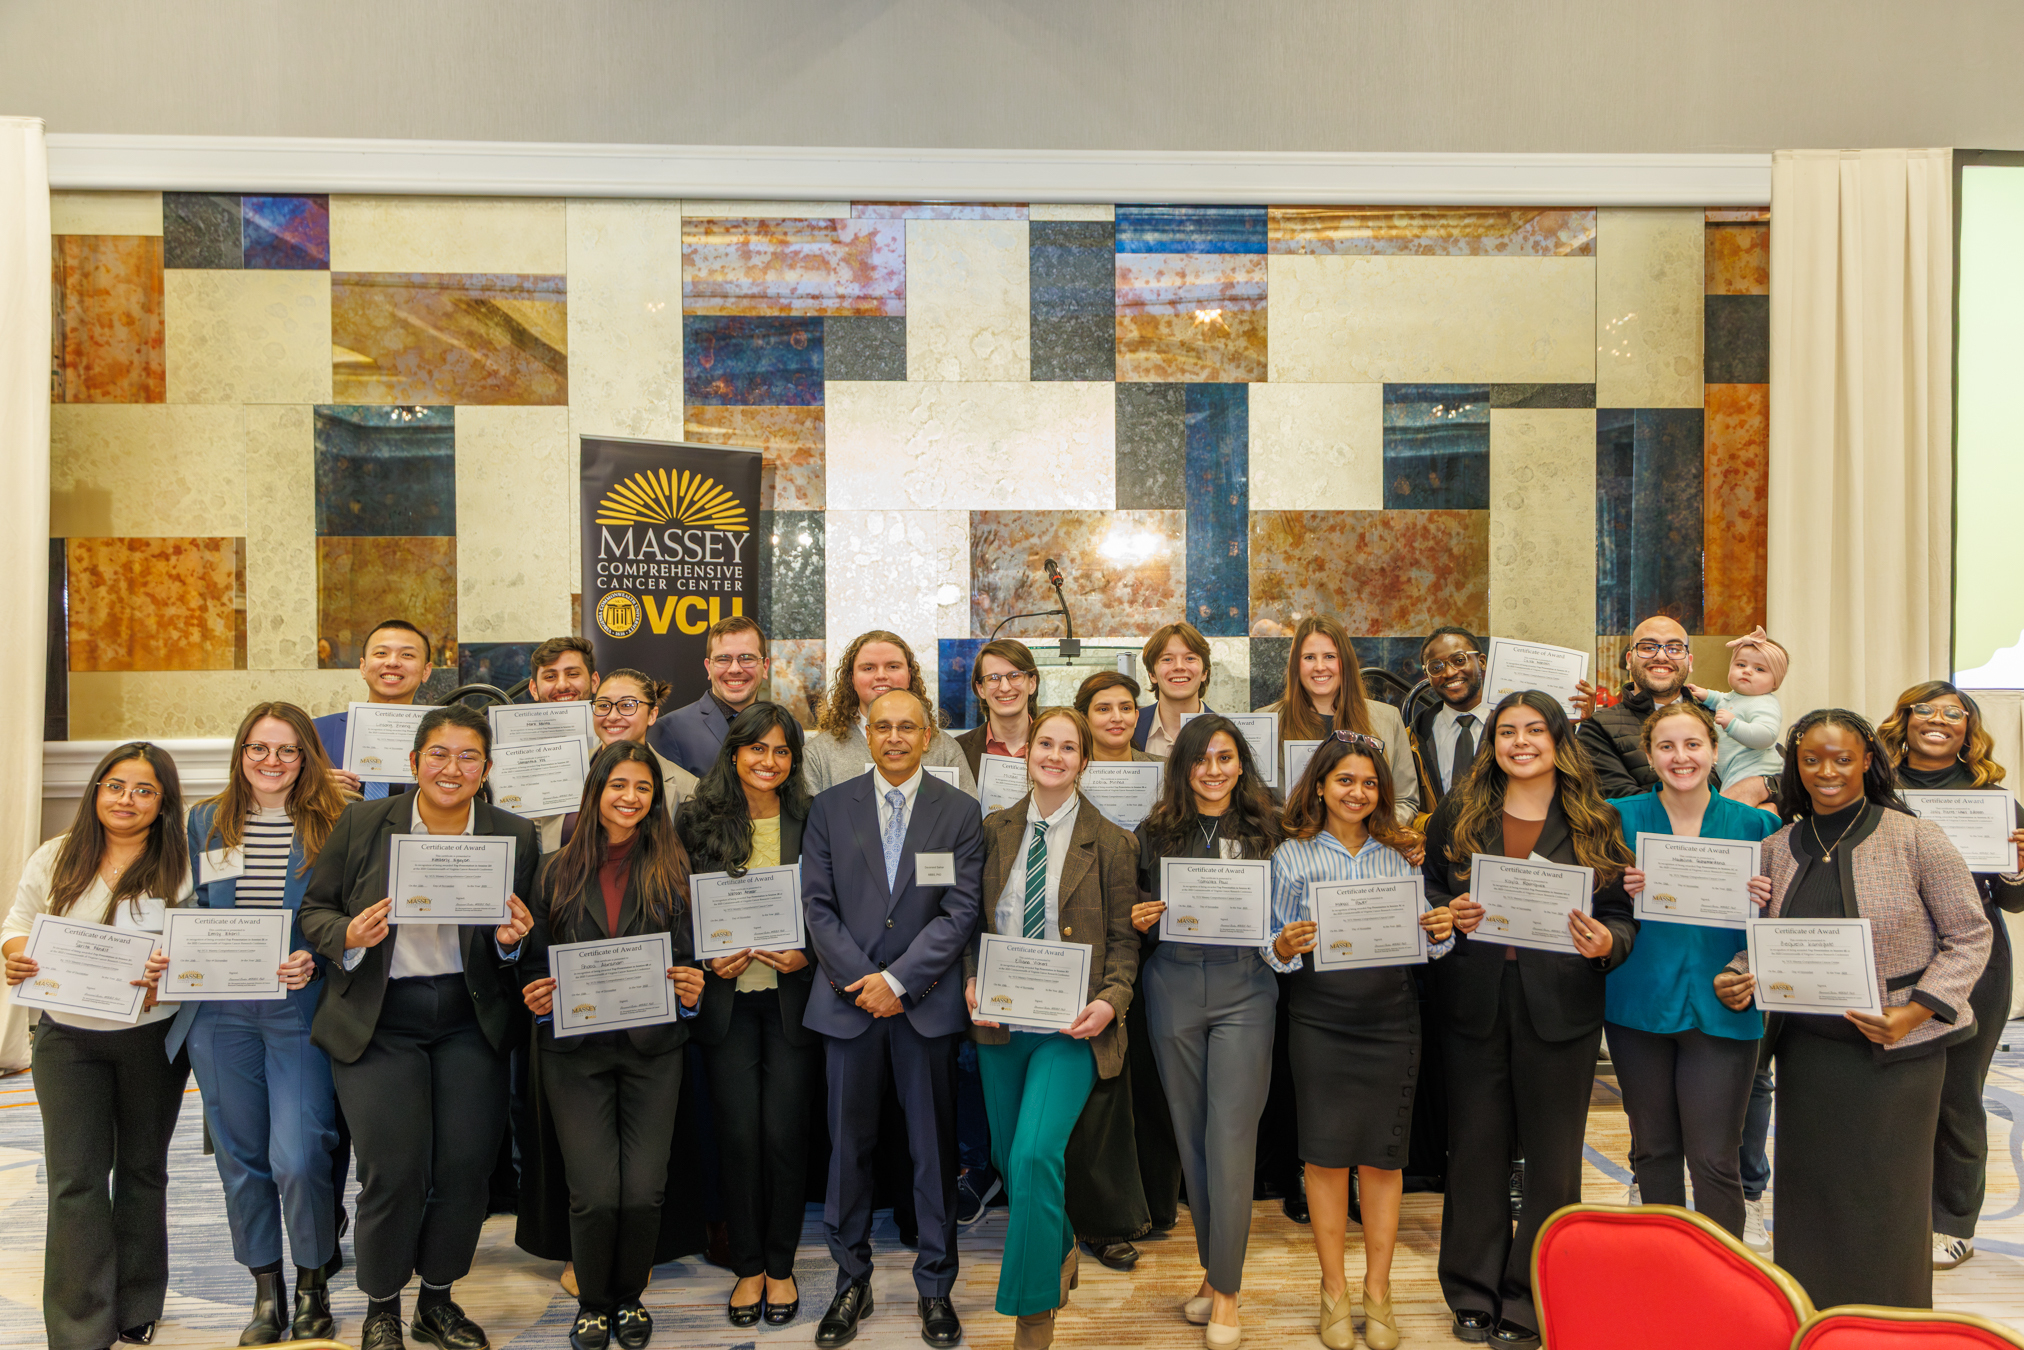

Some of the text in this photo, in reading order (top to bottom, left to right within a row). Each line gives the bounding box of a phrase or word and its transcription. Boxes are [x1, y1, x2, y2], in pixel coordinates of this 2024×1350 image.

[598, 526, 750, 563] MASSEY
[597, 562, 743, 578] COMPREHENSIVE
[597, 578, 743, 591] CANCER CENTER
[641, 595, 743, 635] VCU
[1500, 866, 1532, 874] Certificate
[1486, 916, 1510, 924] MASSEY
[64, 927, 98, 939] Certificate
[107, 936, 131, 944] Award
[1007, 945, 1036, 953] Certificate
[34, 980, 62, 989] MASSEY
[572, 1005, 597, 1014] MASSEY
